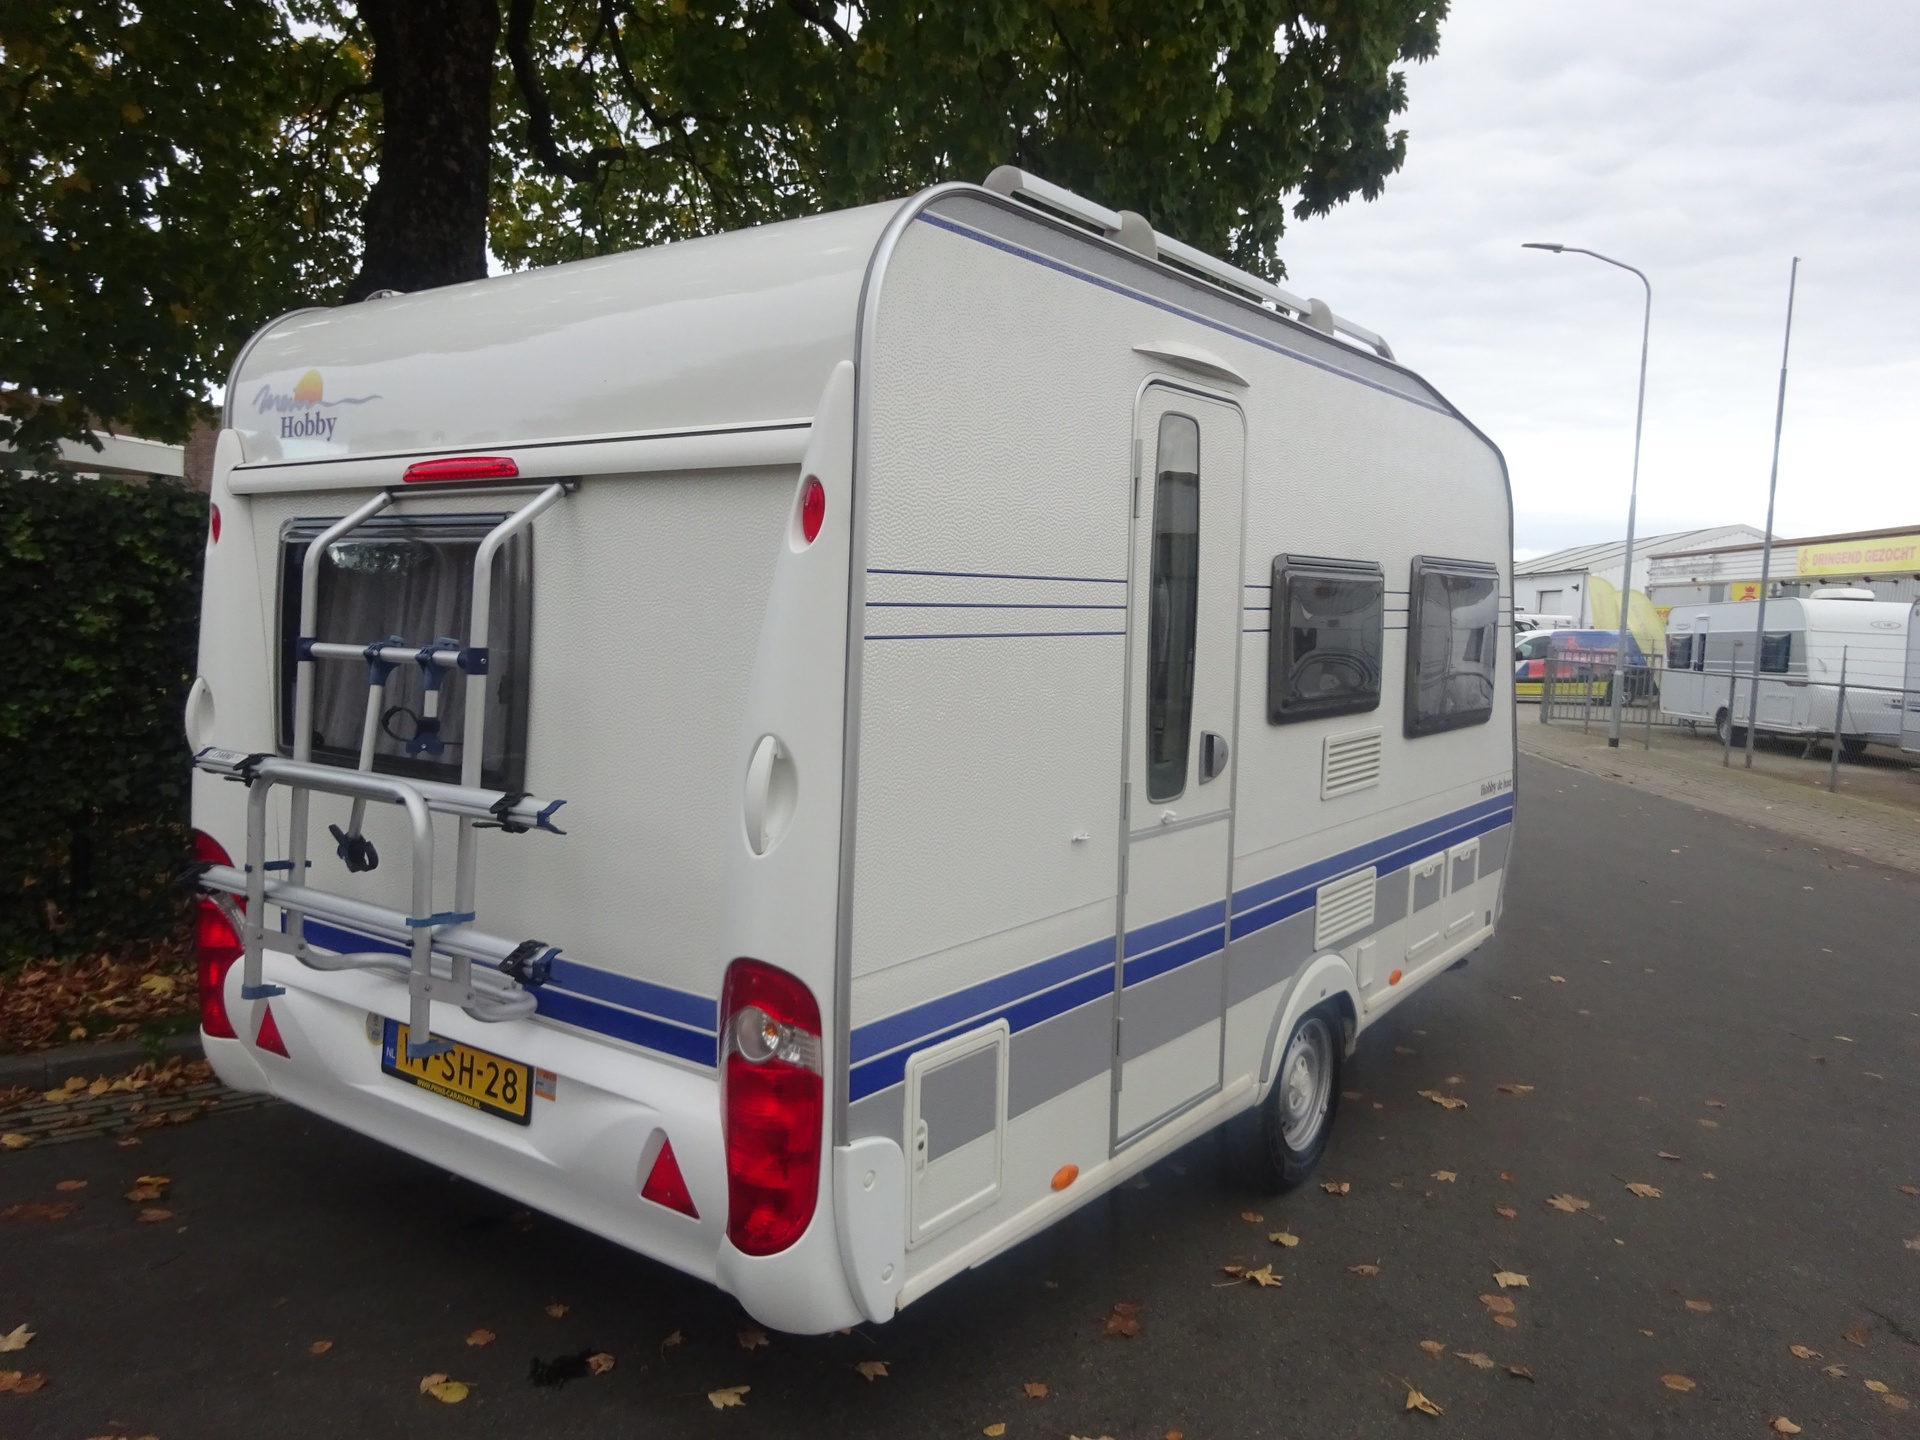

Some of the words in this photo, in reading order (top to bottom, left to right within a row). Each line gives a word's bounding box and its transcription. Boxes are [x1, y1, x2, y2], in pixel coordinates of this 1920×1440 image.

[281, 411, 337, 441] Hobby
[1812, 550, 1862, 566] DRINGEND
[1865, 546, 1917, 563] GEZOCHT
[1480, 780, 1497, 796] Hobby
[386, 1046, 395, 1059] NL
